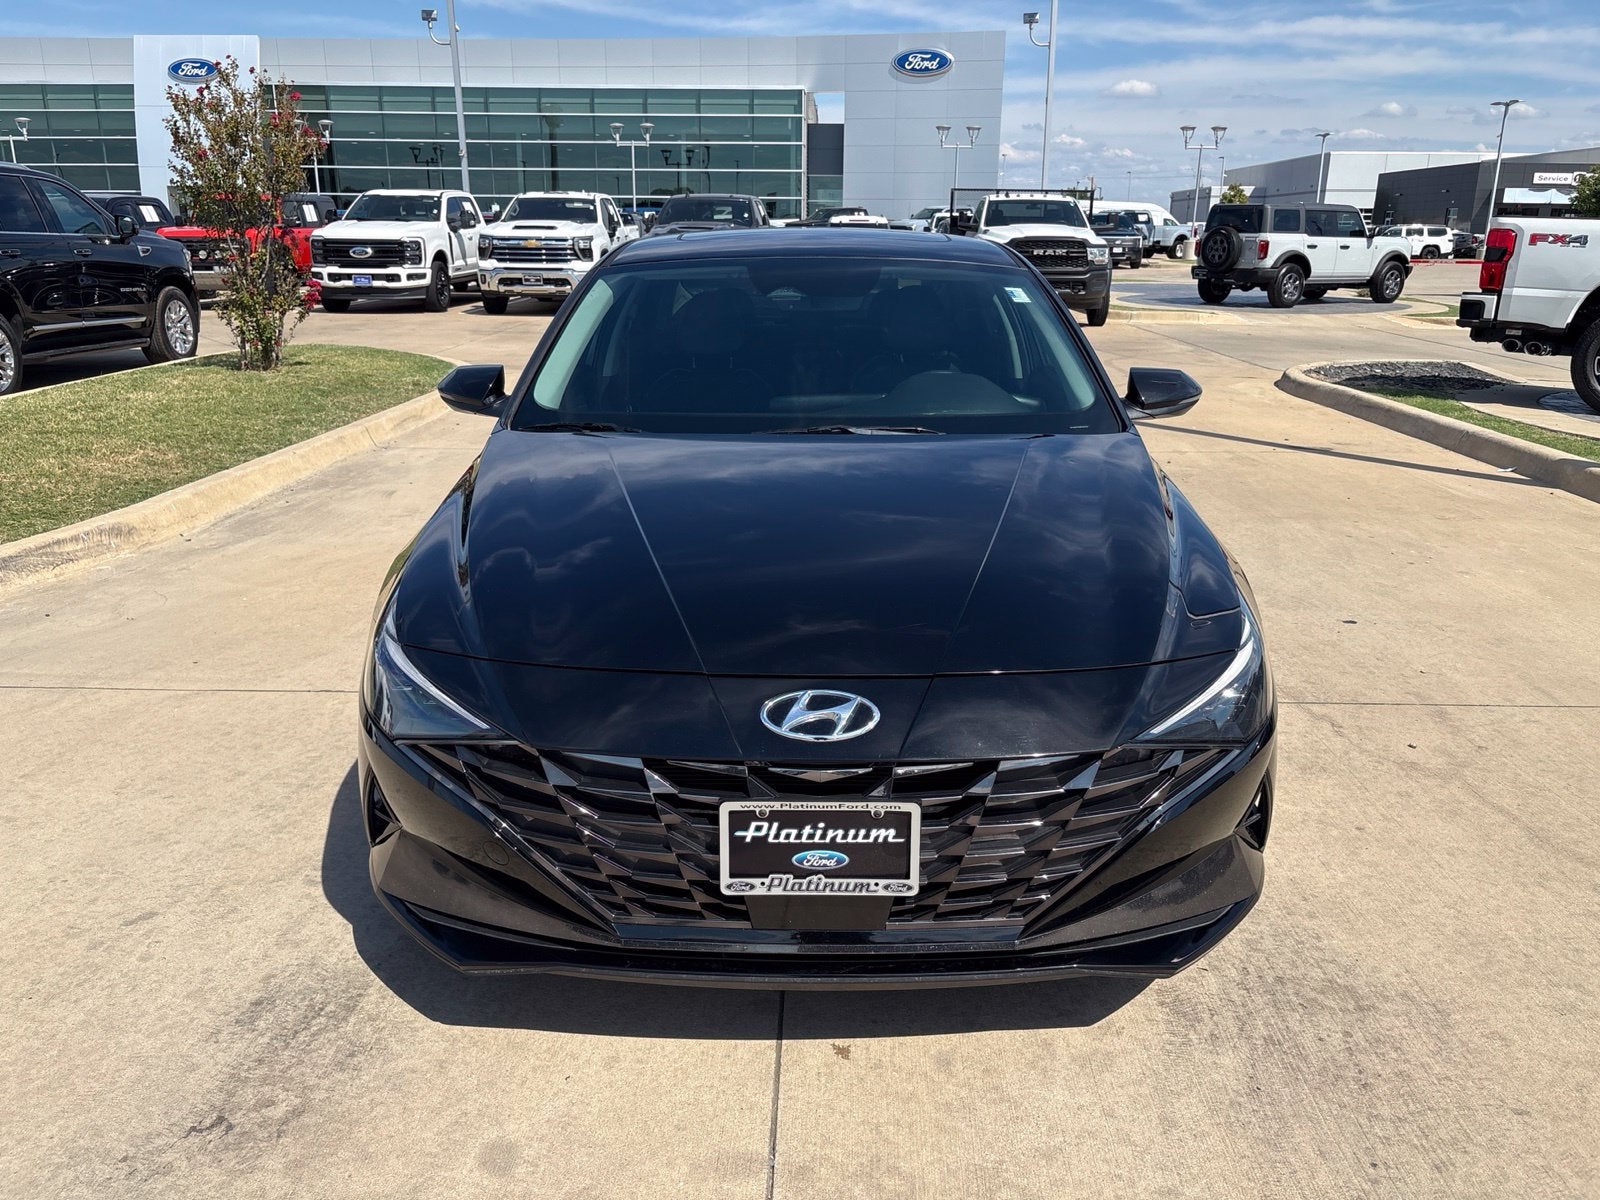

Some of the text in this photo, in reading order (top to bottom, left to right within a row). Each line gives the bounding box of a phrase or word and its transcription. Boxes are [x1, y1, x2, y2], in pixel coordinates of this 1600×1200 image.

[178, 62, 208, 76] Ford
[905, 54, 940, 70] Ford
[1538, 174, 1569, 182] Service
[1528, 233, 1589, 246] FX4
[734, 822, 905, 843] Platinum
[803, 853, 838, 867] Ford
[730, 882, 751, 891] Ford
[764, 875, 879, 894] Platinum
[887, 883, 908, 892] Ford
